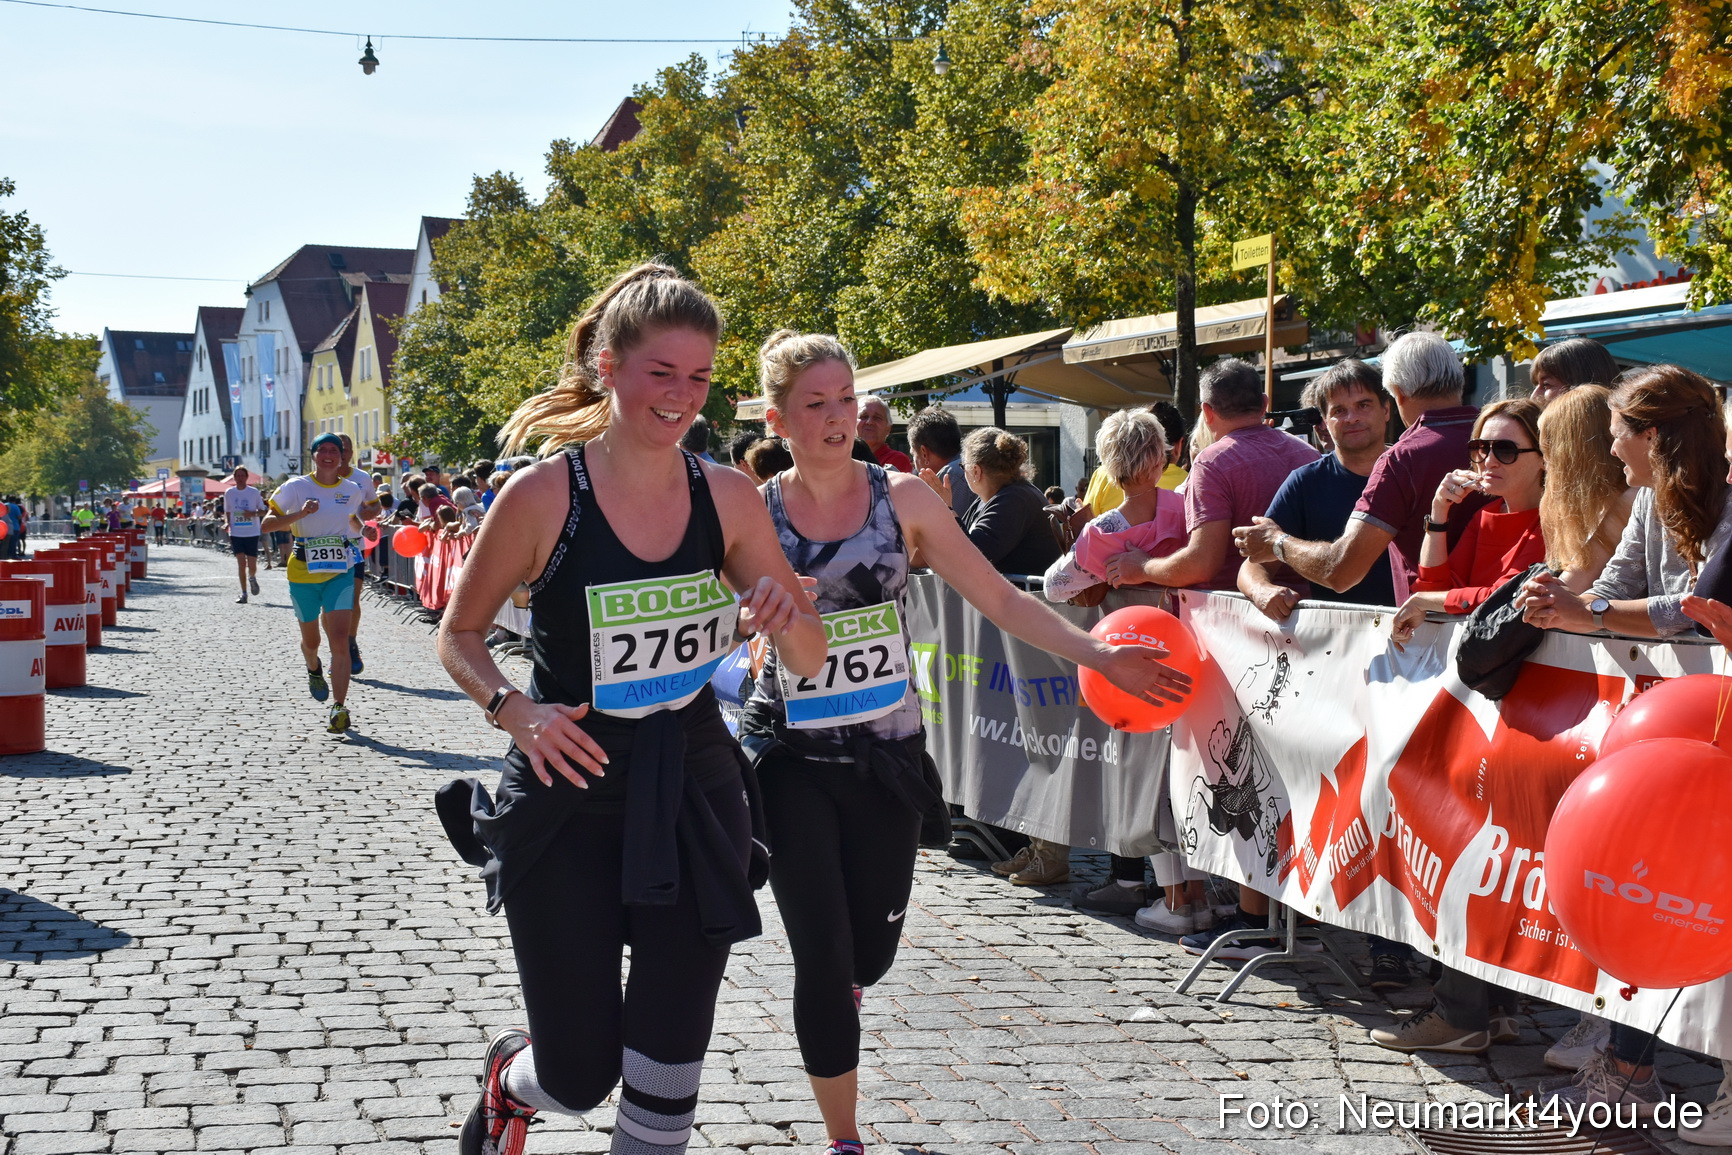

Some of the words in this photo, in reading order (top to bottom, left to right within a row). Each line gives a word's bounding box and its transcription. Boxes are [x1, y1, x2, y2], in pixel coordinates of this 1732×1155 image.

[1240, 246, 1269, 261] Toiletten
[572, 460, 582, 472] DO
[576, 472, 589, 491] JUST
[311, 549, 343, 560] 2819
[603, 577, 725, 620] BOCK
[612, 616, 720, 675] 2761
[624, 669, 698, 703] ANNELI
[823, 692, 878, 719] NINA
[1477, 757, 1488, 782] 1929
[1466, 823, 1556, 916] Bra
[1584, 858, 1726, 925] RÖDL
[1518, 918, 1552, 943] Sicher
[1653, 912, 1720, 936] energie
